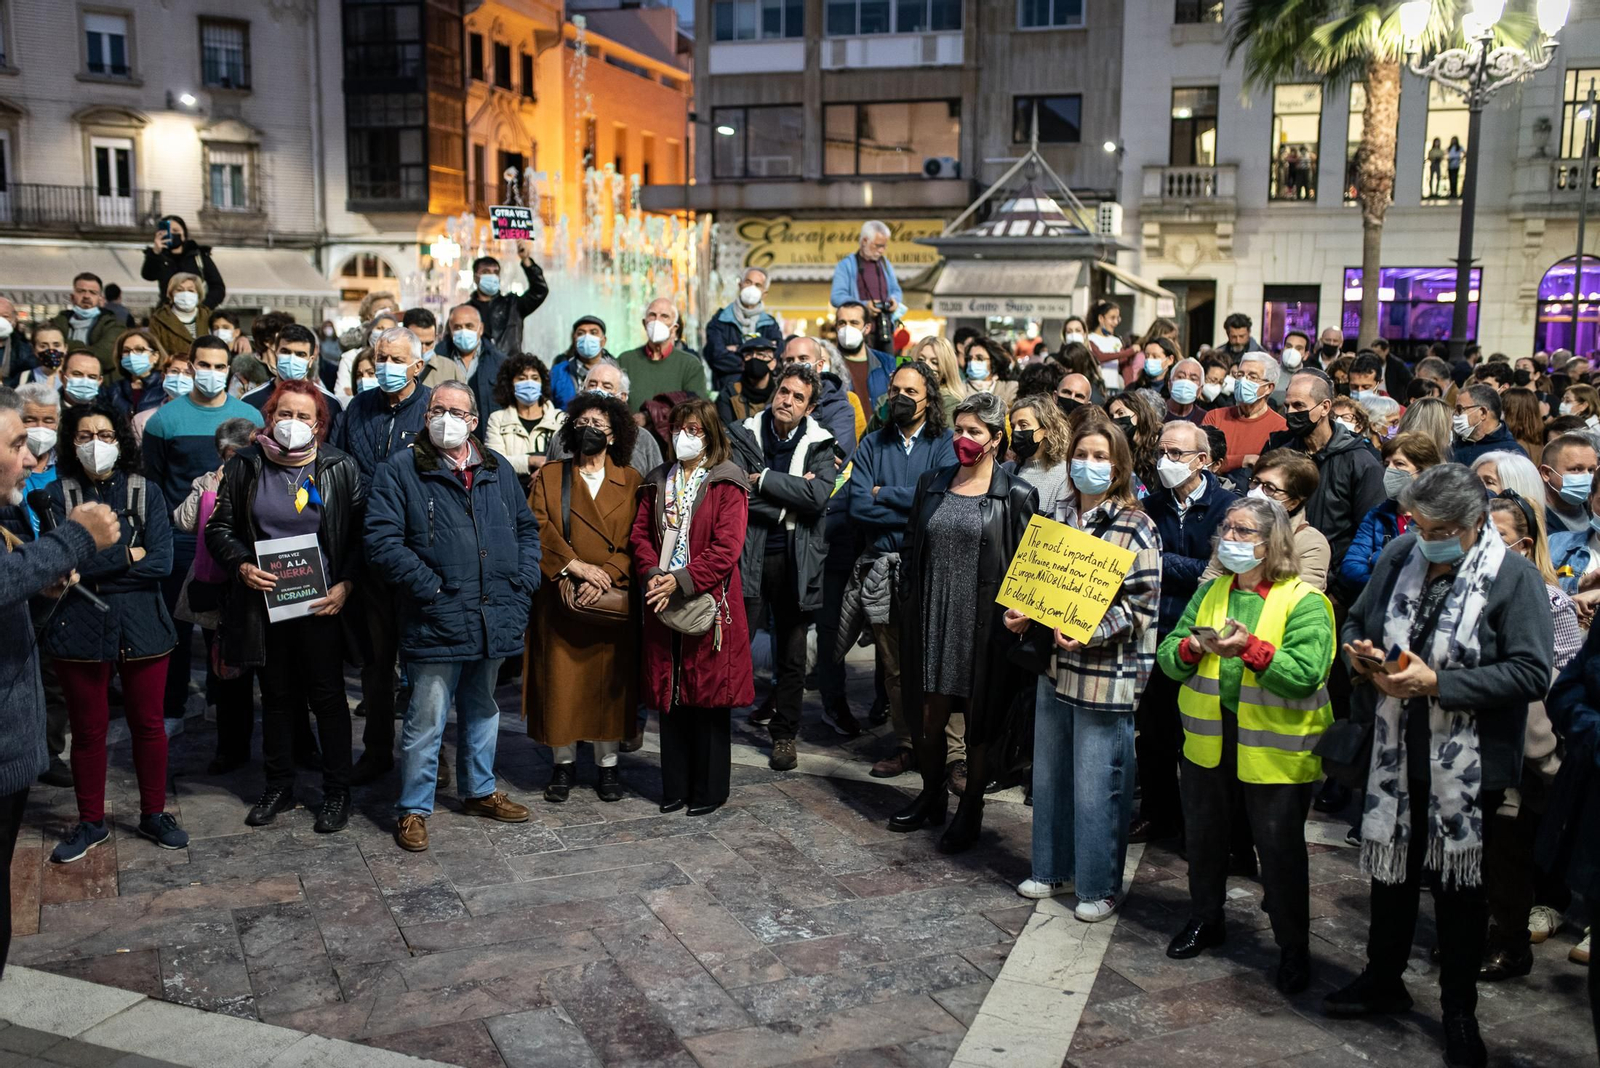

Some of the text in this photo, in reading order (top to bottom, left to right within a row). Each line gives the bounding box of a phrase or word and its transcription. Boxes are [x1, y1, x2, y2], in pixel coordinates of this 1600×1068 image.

[494, 209, 529, 218] OTRA VEZ
[498, 217, 527, 228] NO A LA
[884, 220, 942, 243] laza
[226, 294, 332, 308] AFETERIA
[1028, 523, 1126, 584] The most important thing
[270, 558, 308, 570] NO A LA
[1052, 562, 1070, 573] need
[1069, 568, 1087, 578] now
[1089, 569, 1109, 588] from
[277, 587, 318, 601] UCRANIA
[1082, 585, 1109, 606] States
[1004, 576, 1017, 596] To
[1035, 596, 1047, 619] sky
[1047, 608, 1063, 618] over
[1063, 602, 1093, 632] Ukraine
